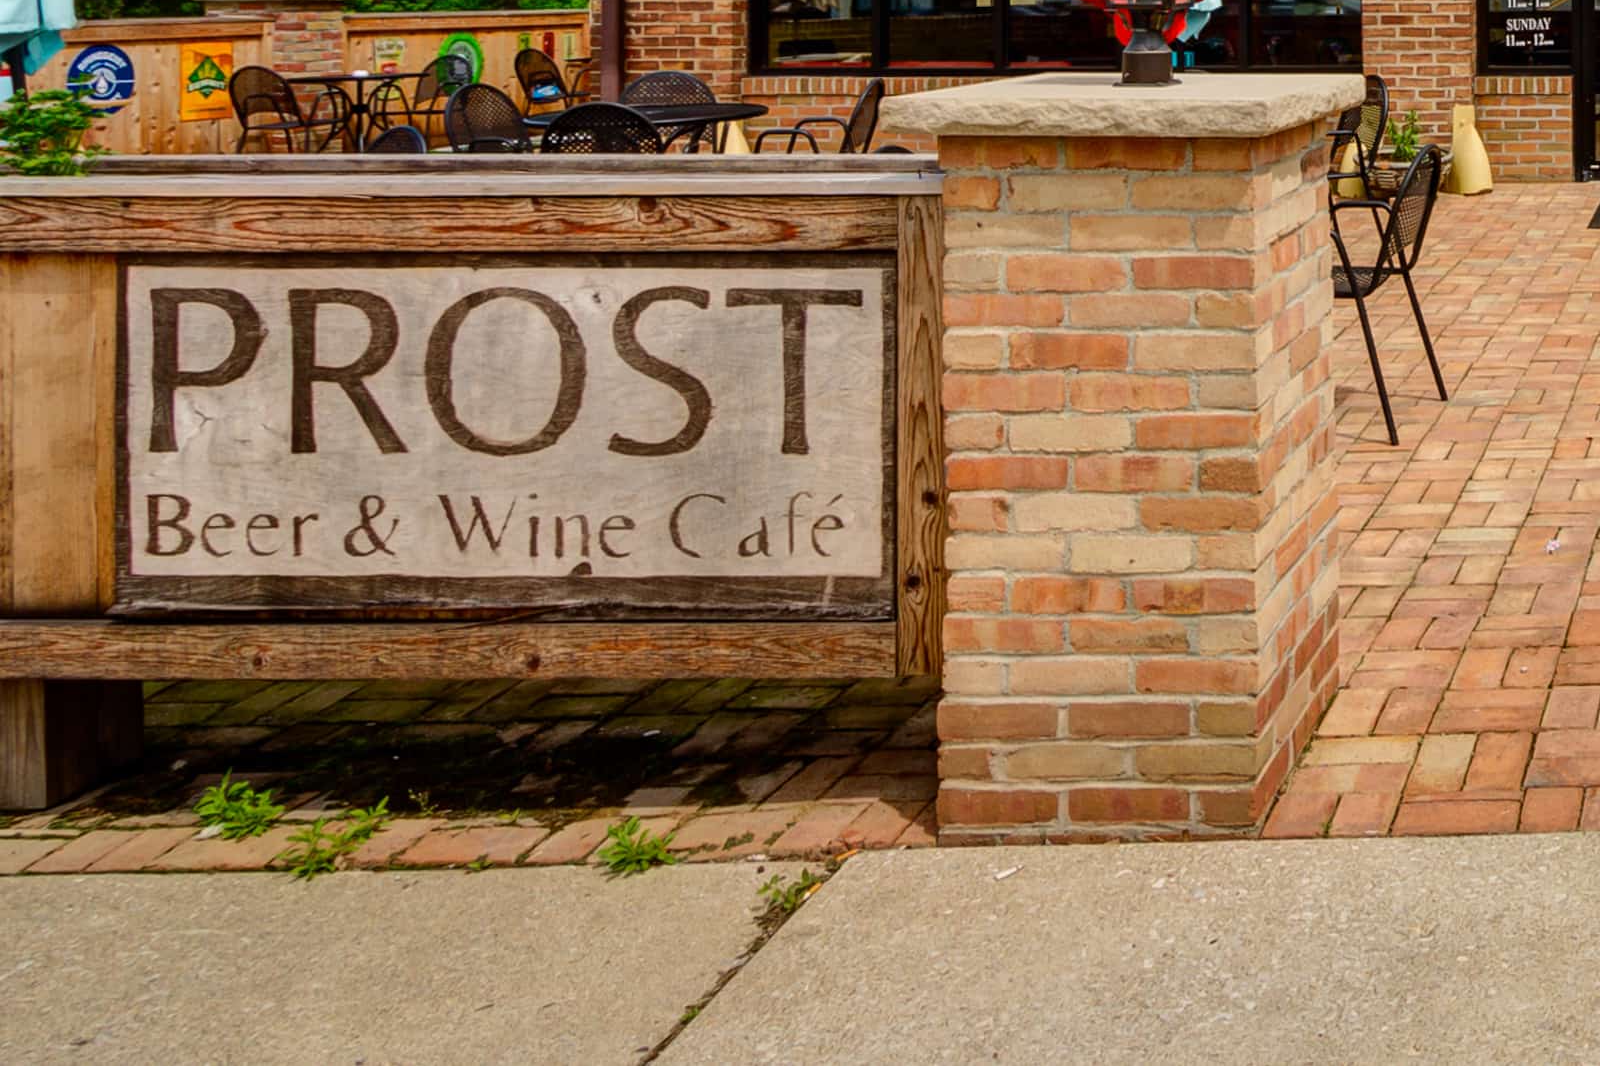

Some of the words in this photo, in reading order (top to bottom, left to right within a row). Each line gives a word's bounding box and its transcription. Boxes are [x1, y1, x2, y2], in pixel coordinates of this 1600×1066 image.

[1506, 17, 1552, 31] SUNDAY
[148, 285, 863, 457] PROST
[144, 492, 319, 557] Beer
[343, 493, 400, 557] &
[438, 492, 636, 559] Wine
[668, 491, 847, 559] Café
